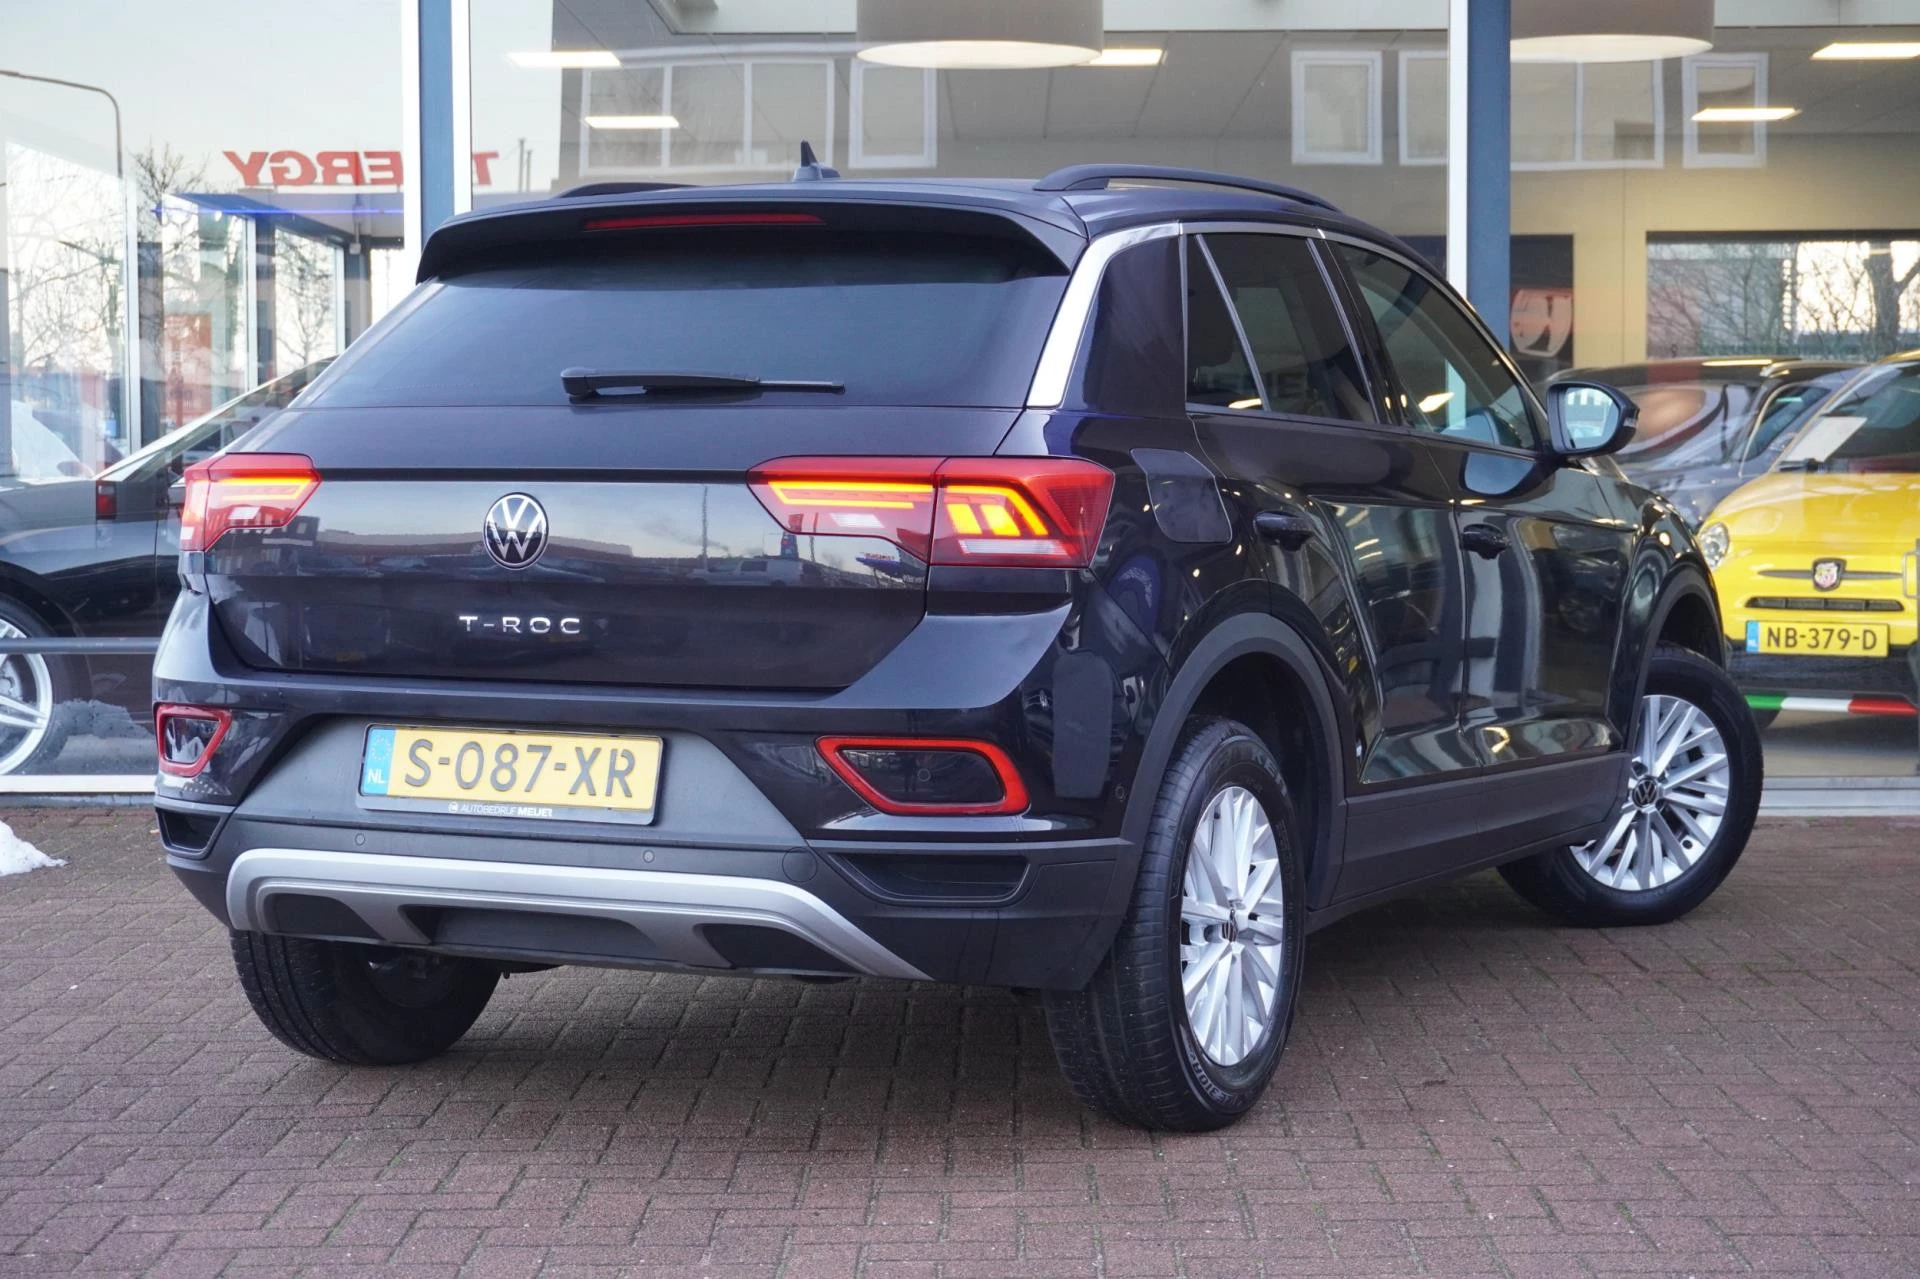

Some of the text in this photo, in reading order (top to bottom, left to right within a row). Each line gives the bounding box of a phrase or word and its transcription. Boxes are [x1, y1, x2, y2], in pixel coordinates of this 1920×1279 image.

[459, 616, 580, 634] T-ROC
[1767, 627, 1877, 650] NB-379-D
[367, 768, 386, 784] NL
[405, 739, 636, 797] S-087-XR
[517, 806, 553, 817] MEIJER
